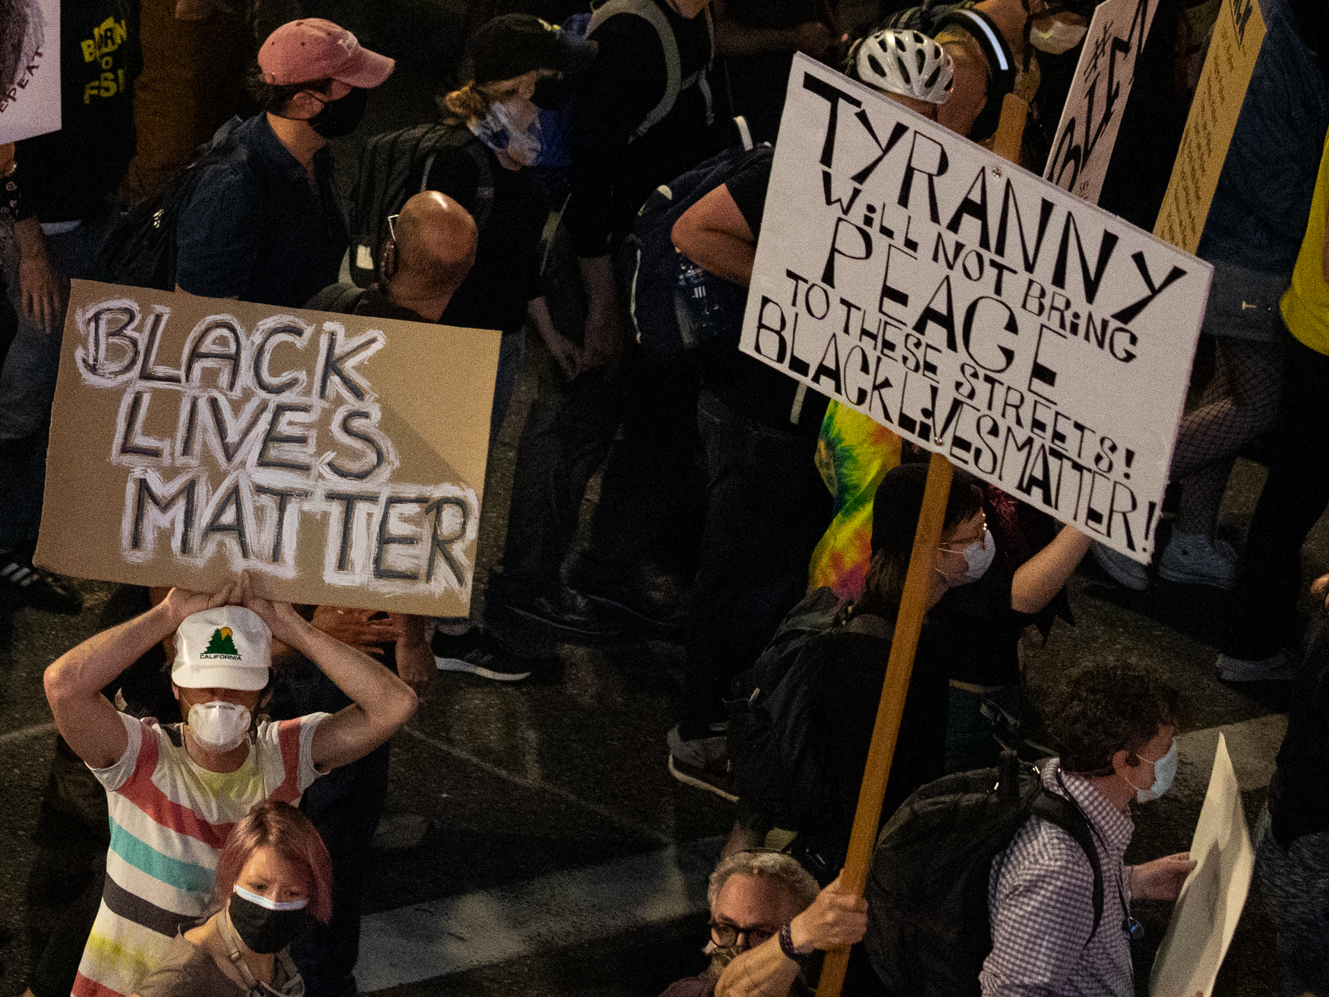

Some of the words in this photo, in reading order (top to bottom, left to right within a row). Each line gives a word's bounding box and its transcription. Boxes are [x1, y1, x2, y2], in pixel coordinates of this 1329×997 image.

[803, 71, 1188, 326] TYRANNY
[932, 231, 1018, 297] NOT
[77, 300, 385, 403] BLACK
[785, 268, 830, 320] TO
[840, 298, 943, 383] THESE
[955, 362, 1137, 481] STREETS!
[822, 216, 1068, 406] PEACE
[115, 388, 396, 483] LIVES
[755, 294, 895, 425] BLACK
[999, 425, 1157, 554] MATTER!
[124, 472, 474, 594] MATTER
